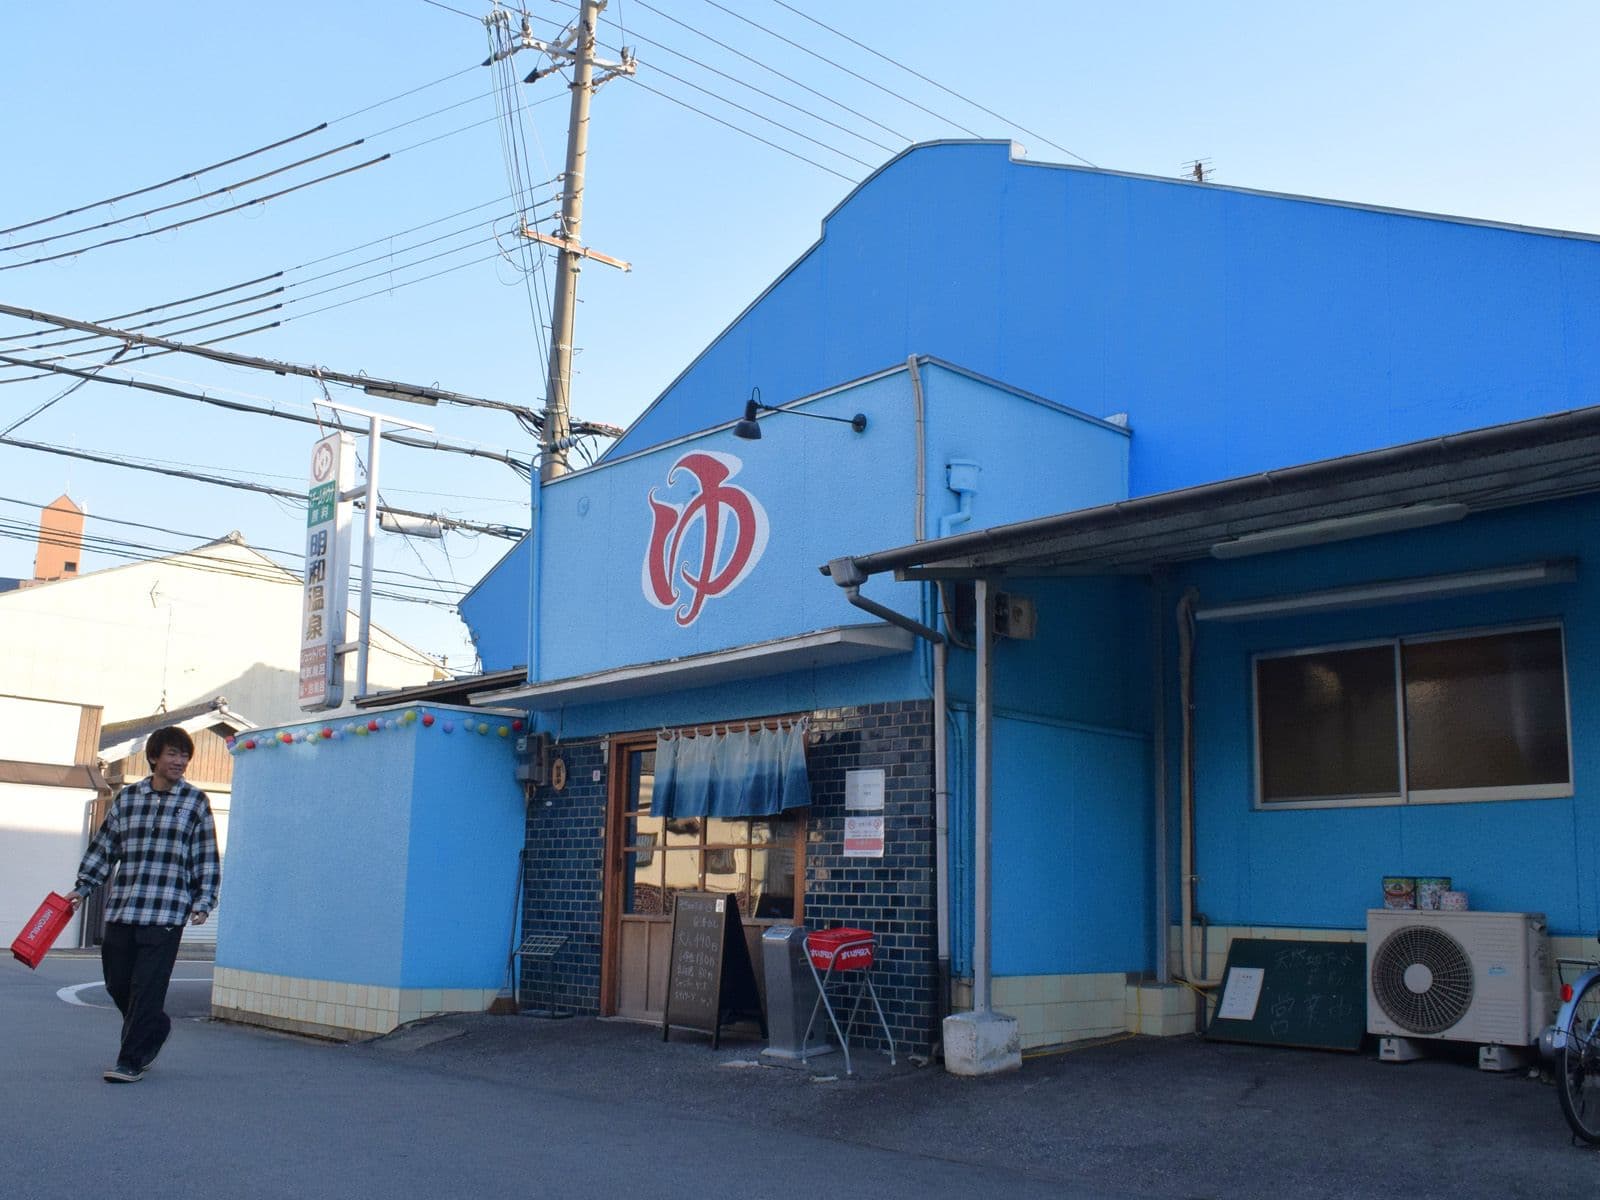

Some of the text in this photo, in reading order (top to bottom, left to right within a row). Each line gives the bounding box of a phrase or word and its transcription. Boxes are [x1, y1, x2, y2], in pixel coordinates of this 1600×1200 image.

[306, 530, 327, 640] 明和温泉
[642, 450, 769, 627] ゆ
[27, 908, 54, 940] MEGMILK
